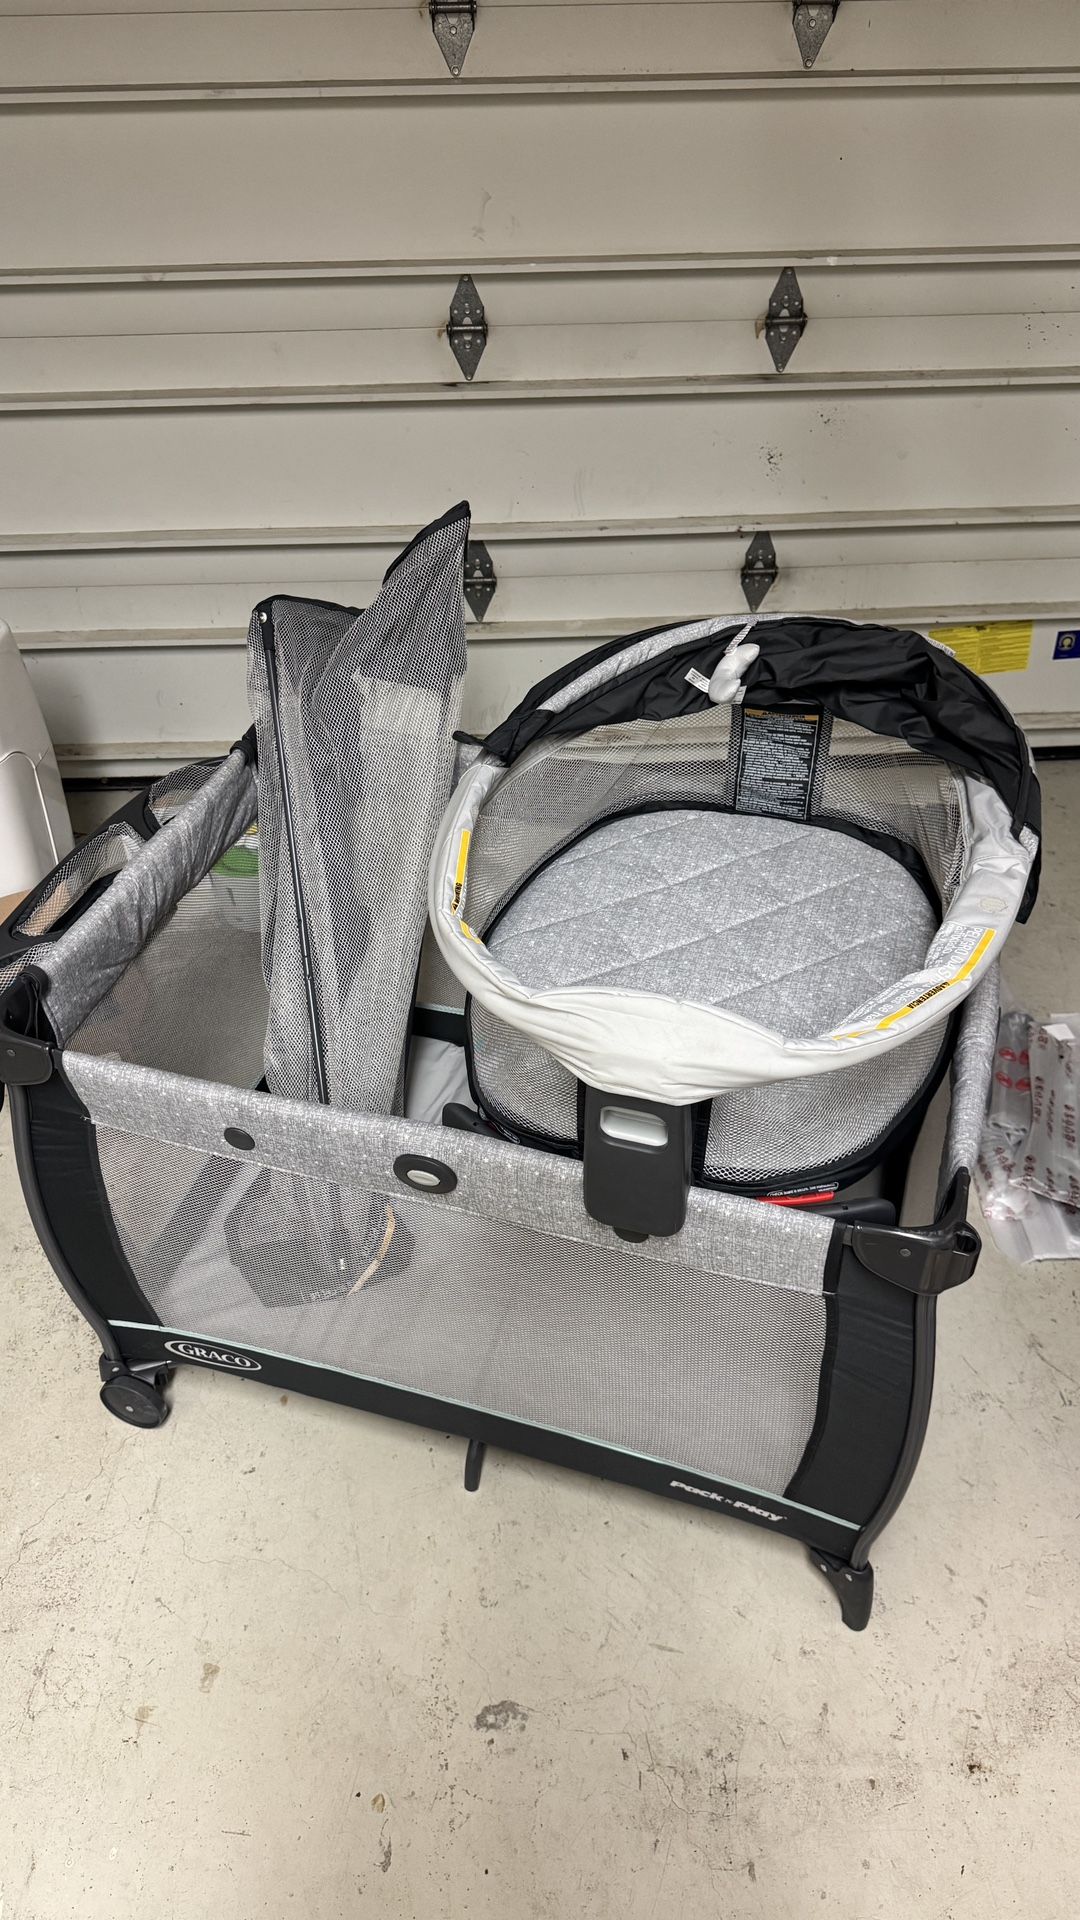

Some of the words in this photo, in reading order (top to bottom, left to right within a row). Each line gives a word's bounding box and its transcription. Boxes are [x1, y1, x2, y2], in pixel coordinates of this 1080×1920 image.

[178, 1343, 251, 1367] GRACO
[669, 1480, 724, 1502] Pack
[733, 1501, 783, 1521] Play
